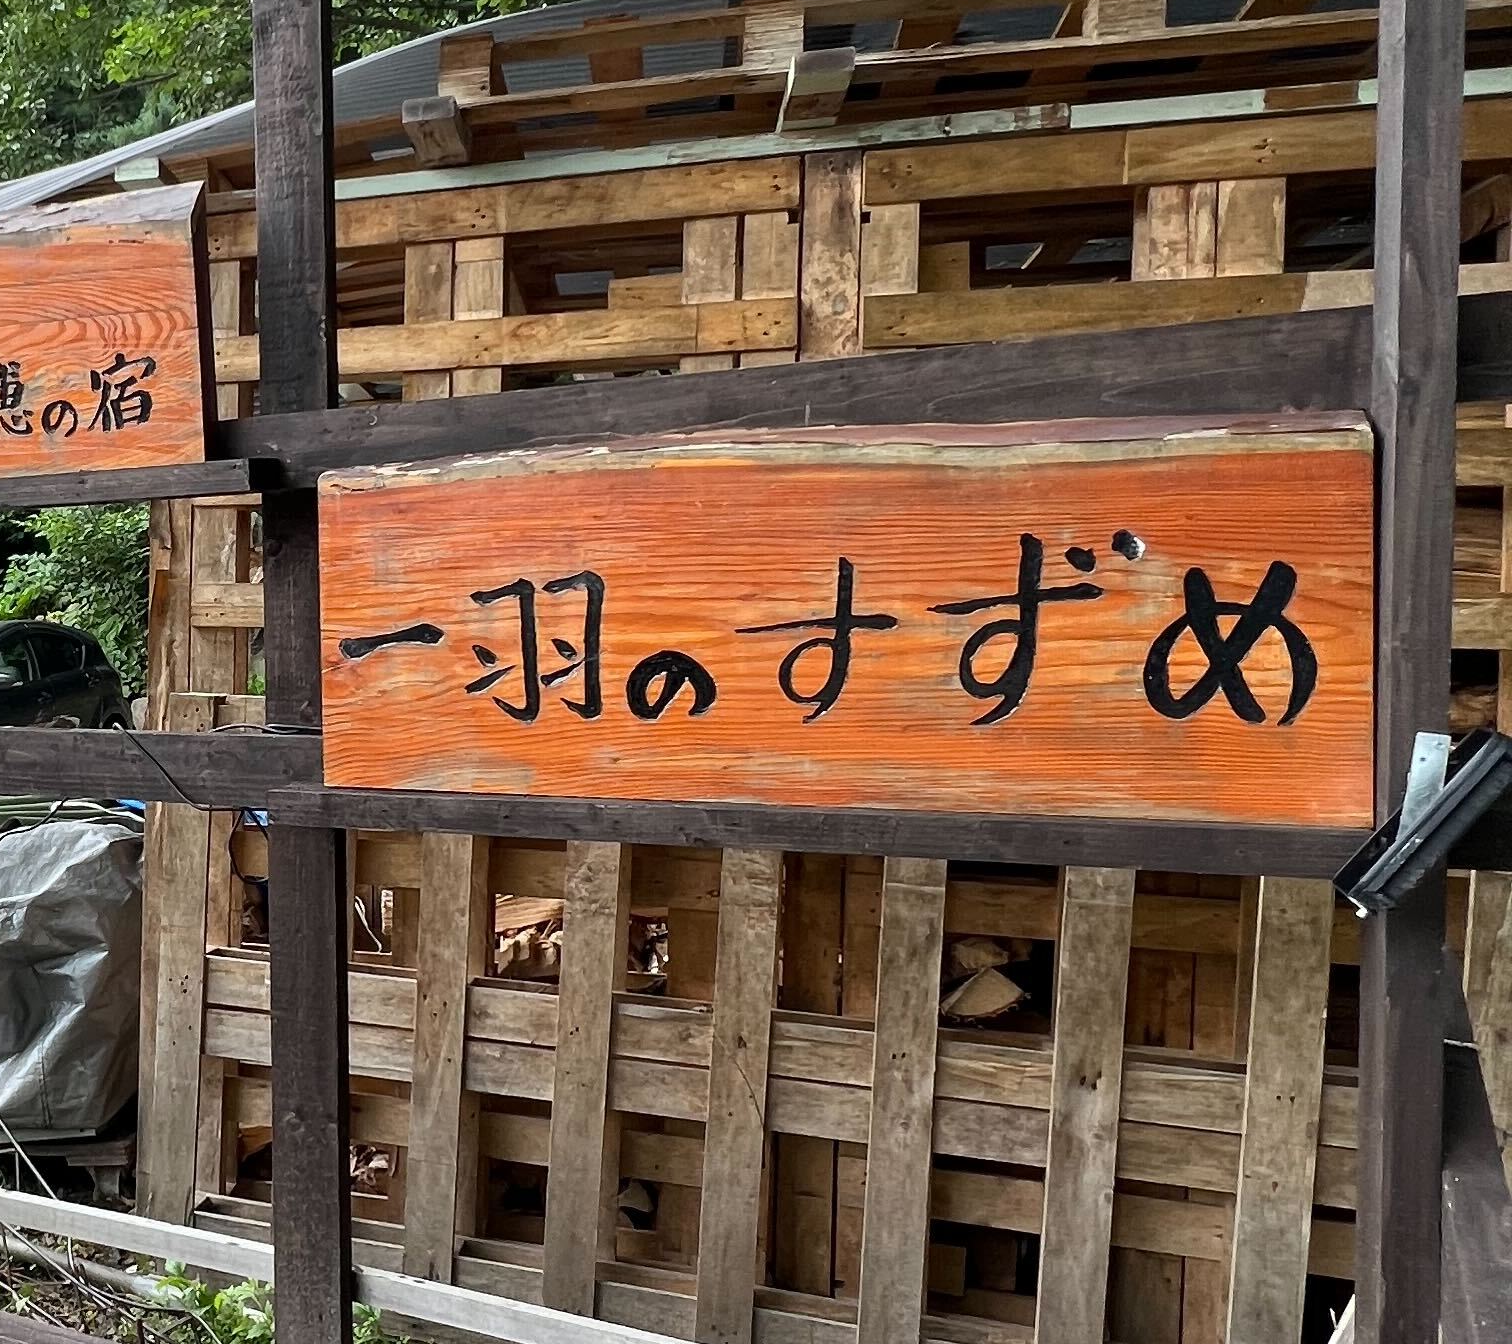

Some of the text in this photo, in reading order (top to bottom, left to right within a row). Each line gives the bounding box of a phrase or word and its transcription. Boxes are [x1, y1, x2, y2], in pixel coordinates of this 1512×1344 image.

[338, 529, 1318, 727] 一羽のすずめ
